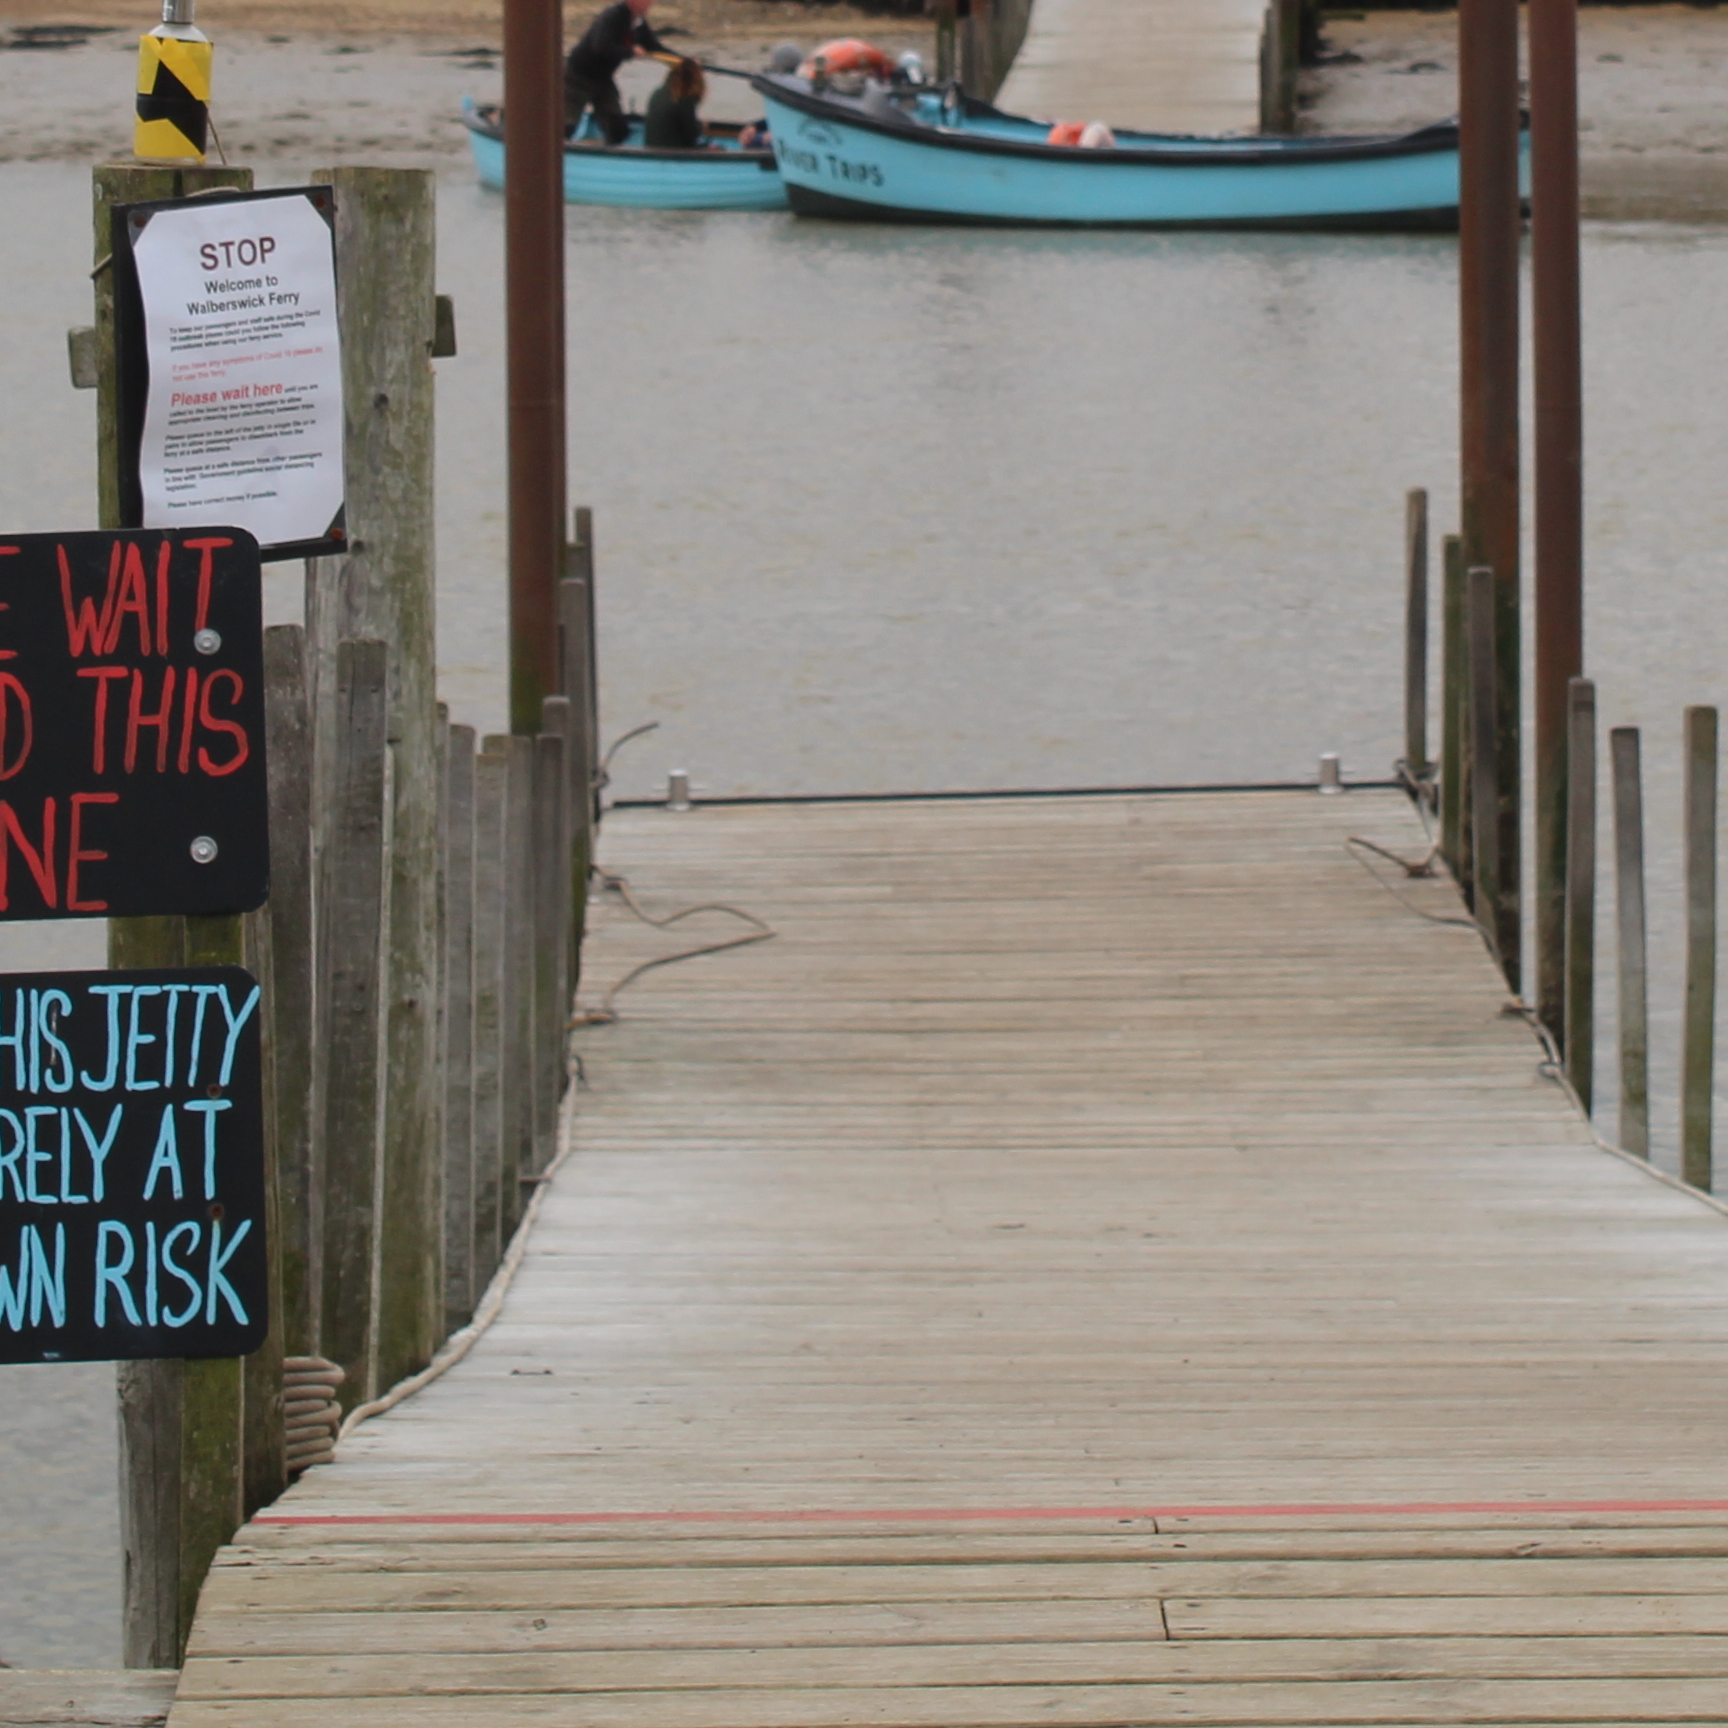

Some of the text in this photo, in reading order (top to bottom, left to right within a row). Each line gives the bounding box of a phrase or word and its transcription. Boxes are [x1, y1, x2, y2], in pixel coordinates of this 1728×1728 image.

[186, 292, 301, 316] Walberswick Ferry
[199, 236, 276, 271] STOP
[204, 275, 279, 294] Welcome to
[170, 388, 217, 407] Please
[221, 384, 250, 401] wait
[252, 380, 283, 397] here
[56, 537, 233, 656] WAIT
[76, 665, 249, 777] THIS
[81, 984, 260, 1091] JETTY
[143, 1100, 233, 1201] AT
[95, 1219, 252, 1328] RISK
